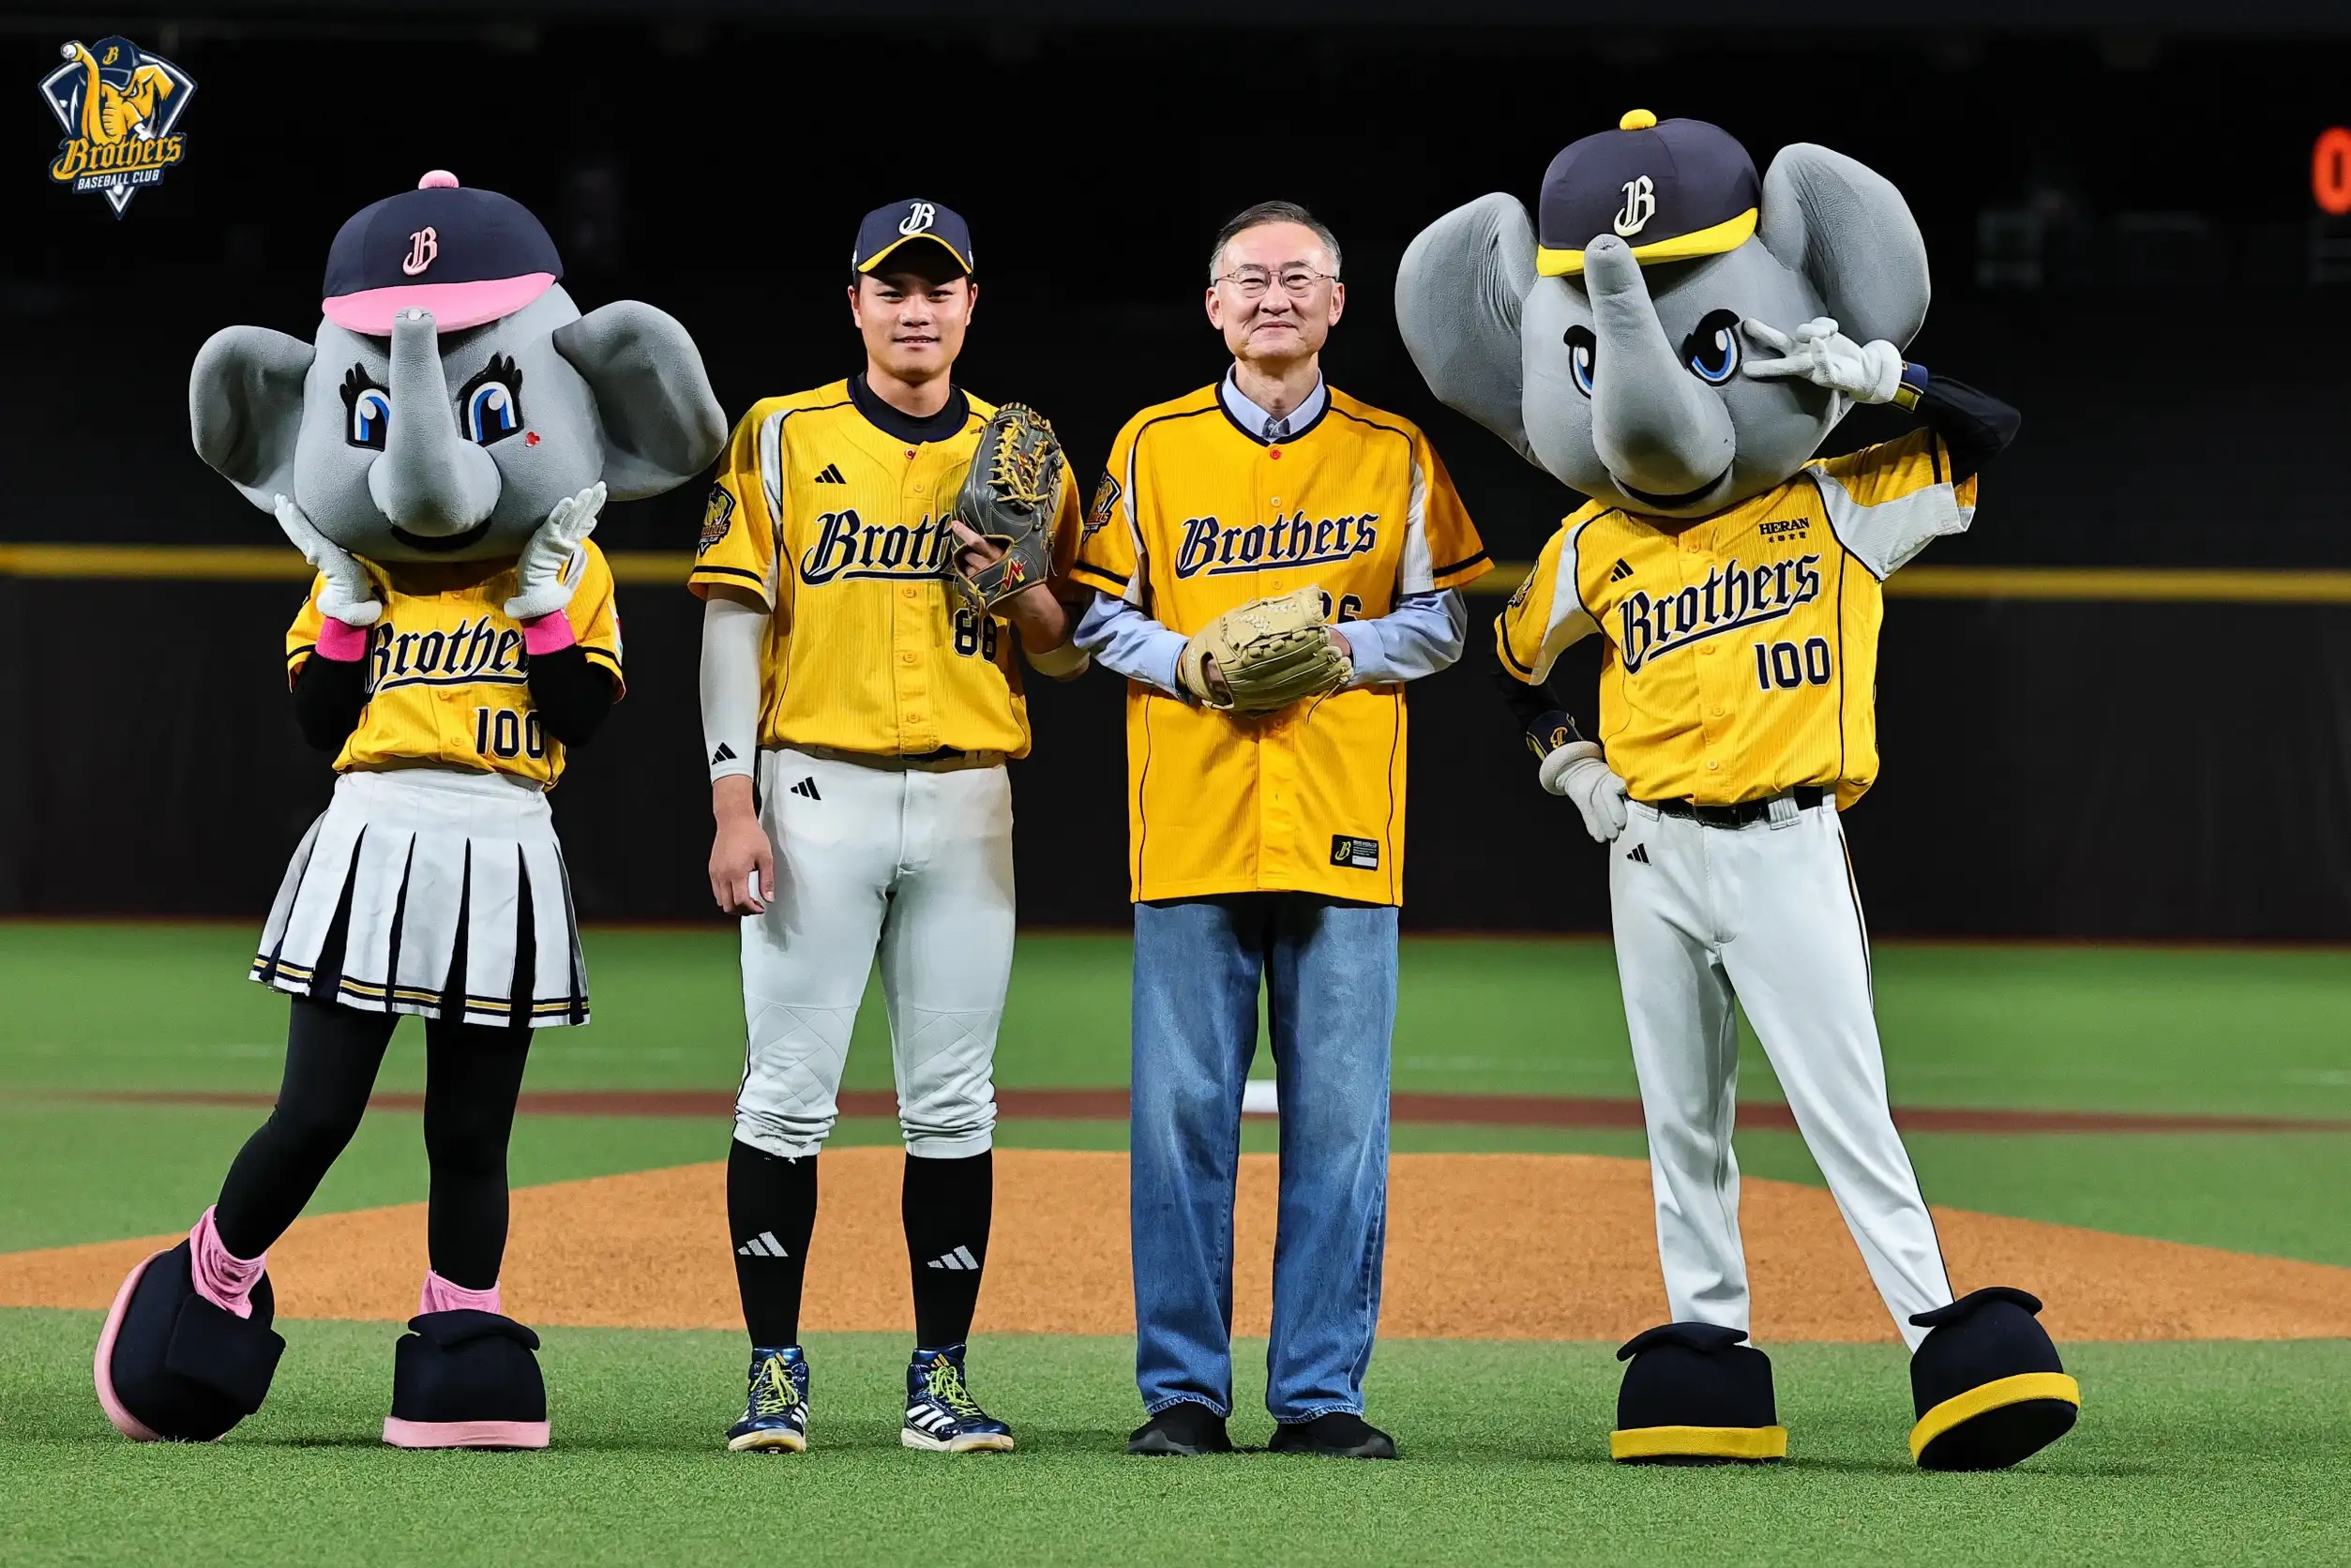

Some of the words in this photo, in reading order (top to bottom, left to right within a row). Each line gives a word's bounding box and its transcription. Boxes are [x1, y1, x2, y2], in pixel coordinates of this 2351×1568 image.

[898, 203, 936, 235] B
[1614, 174, 1655, 236] B
[402, 226, 438, 276] B
[799, 507, 955, 587] Broth
[1175, 509, 1380, 580] Brothers
[1758, 517, 1810, 535] HERAN
[1619, 552, 1821, 675] Brothers
[365, 613, 529, 705] Brothe
[1753, 636, 1834, 692] 100
[475, 706, 548, 761] 100
[1334, 840, 1351, 861] B
